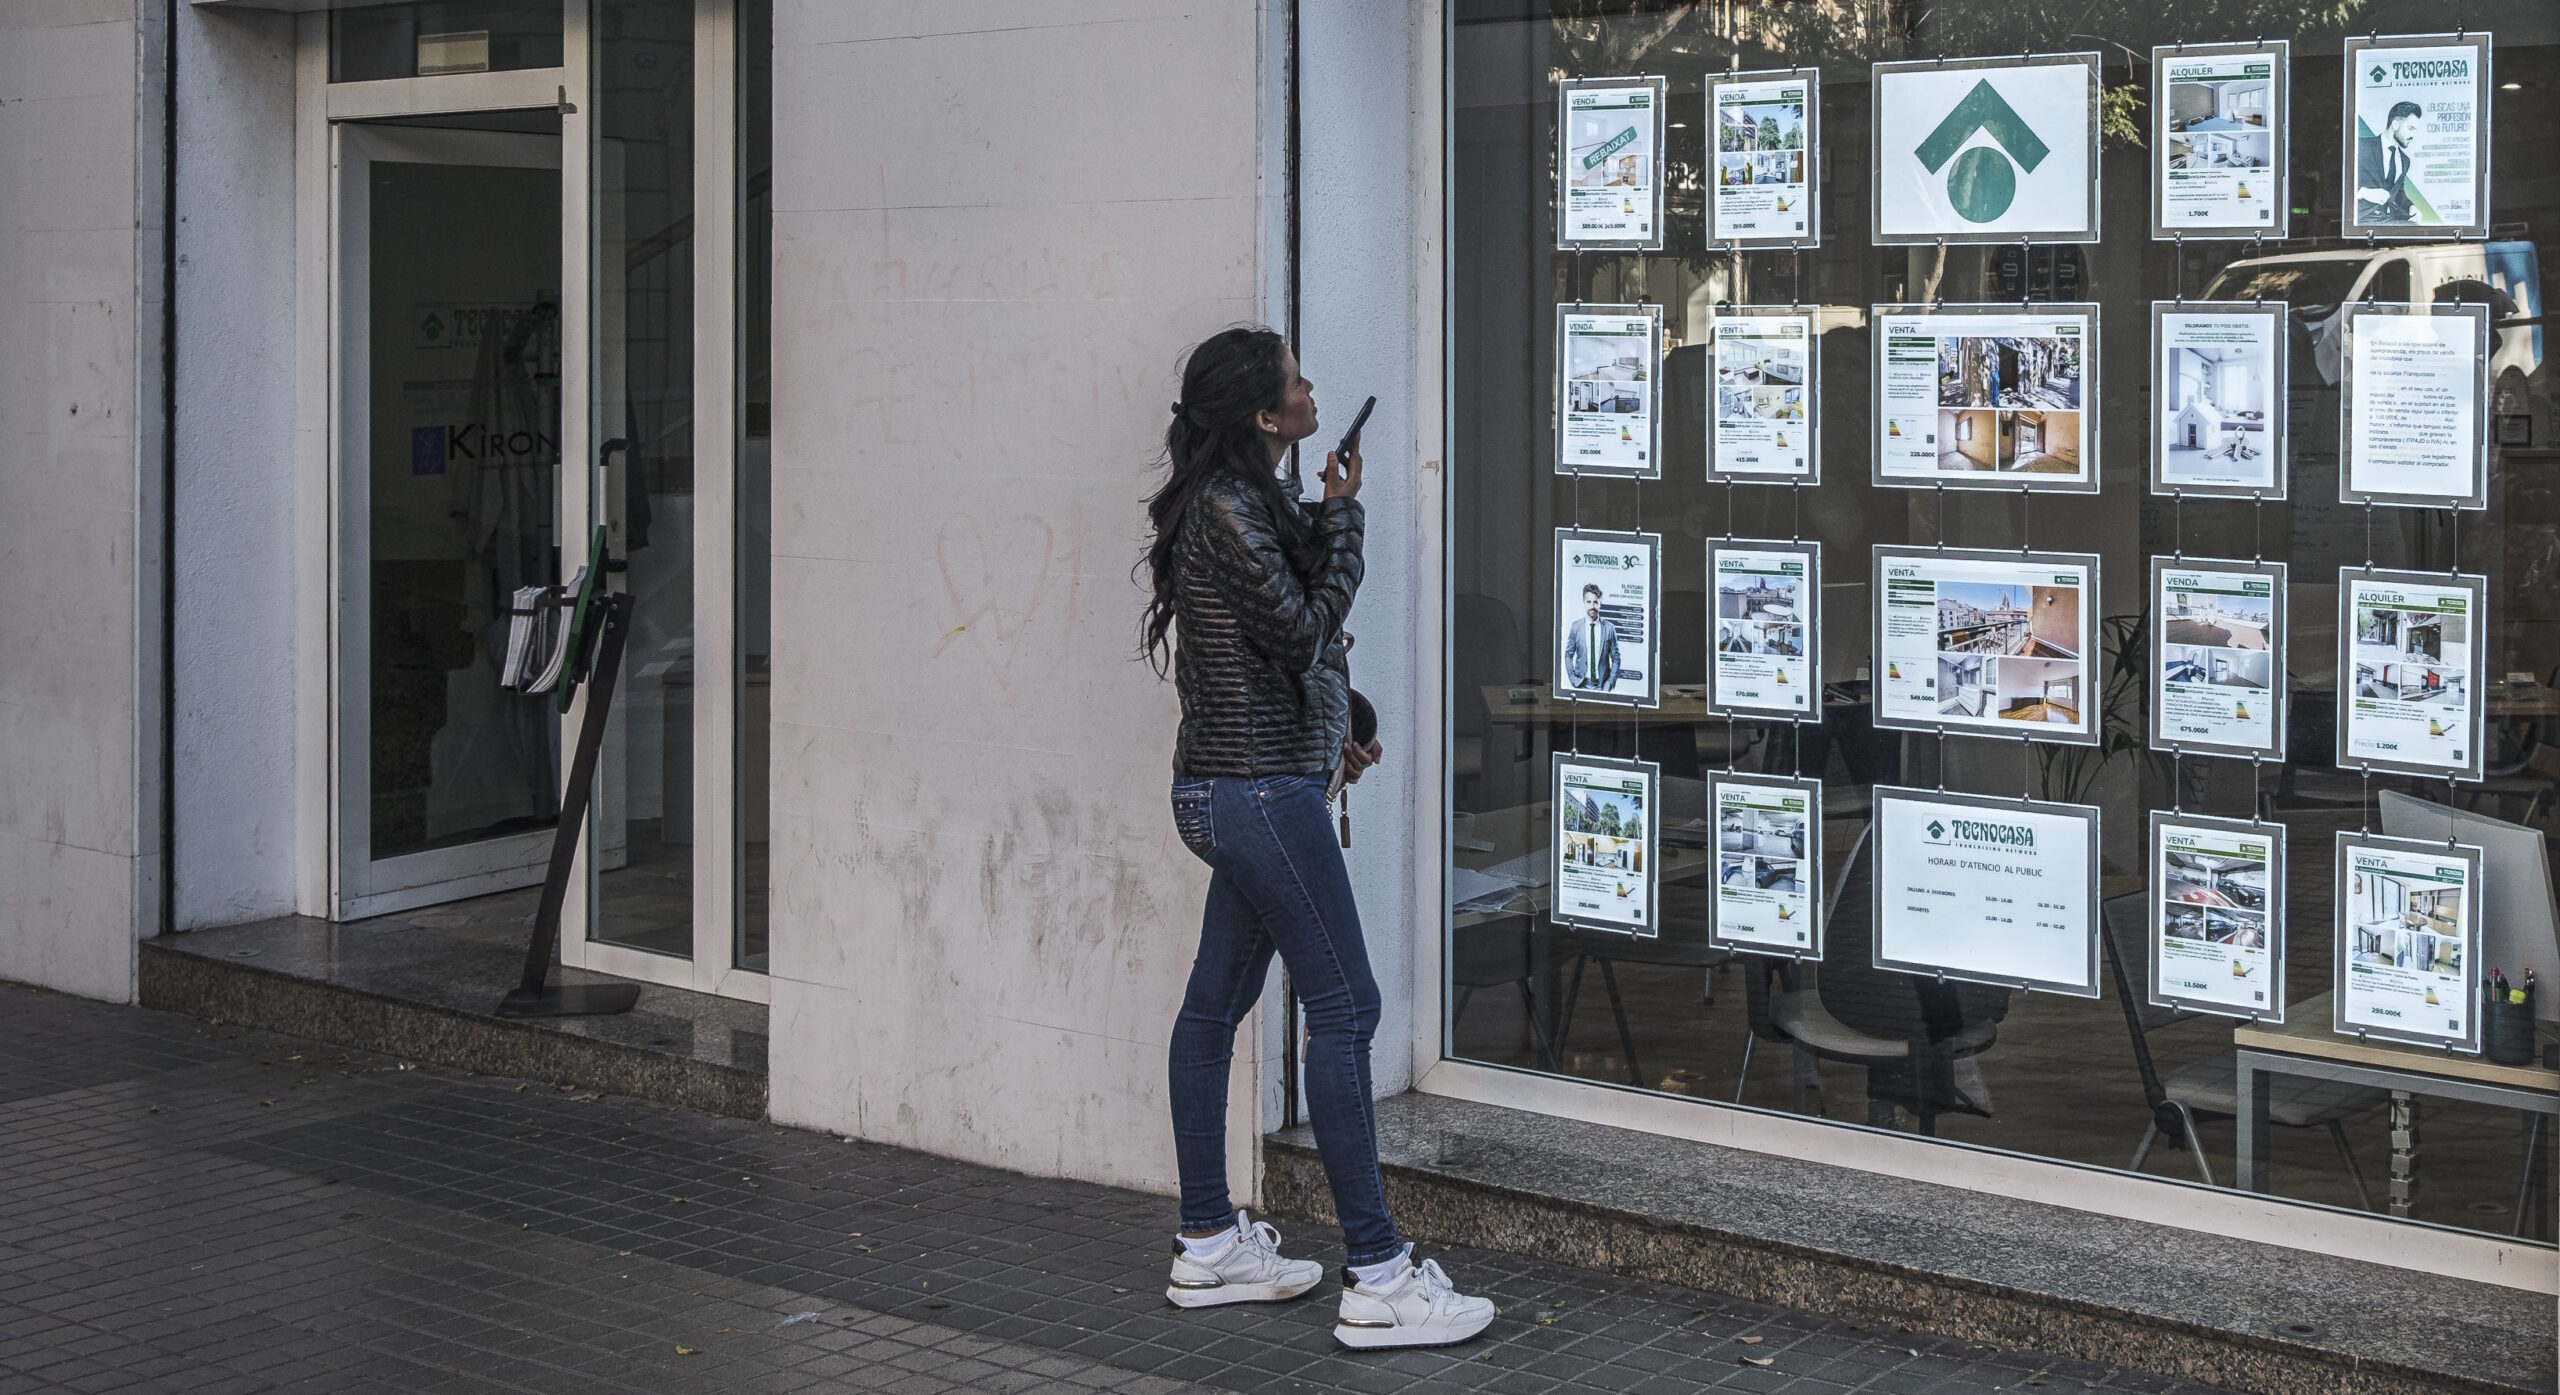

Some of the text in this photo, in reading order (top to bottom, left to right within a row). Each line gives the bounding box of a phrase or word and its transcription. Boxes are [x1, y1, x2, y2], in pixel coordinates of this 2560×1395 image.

[2170, 67, 2212, 77] ALQUILER
[2393, 60, 2468, 80] TECNOCASA
[1589, 131, 1631, 165] REBAIXAT
[1889, 326, 1916, 334] VENTA
[1584, 554, 1618, 566] TECNOCASA
[1889, 569, 1915, 577] VENTA
[2167, 577, 2198, 586] VENDA
[2358, 593, 2404, 603] ALQUILER
[1564, 775, 1588, 783] VENTA
[1721, 793, 1745, 801] VENTA
[1952, 820, 2034, 847] TECNOCASA
[2166, 836, 2195, 846] VENTA
[1956, 843, 2037, 856] FRANCHISING NETWORK
[1928, 857, 2043, 877] HORARI D'ATENCIO AL PUBLIC
[2356, 856, 2387, 868] VENTA
[2184, 981, 2207, 990] 13.500€
